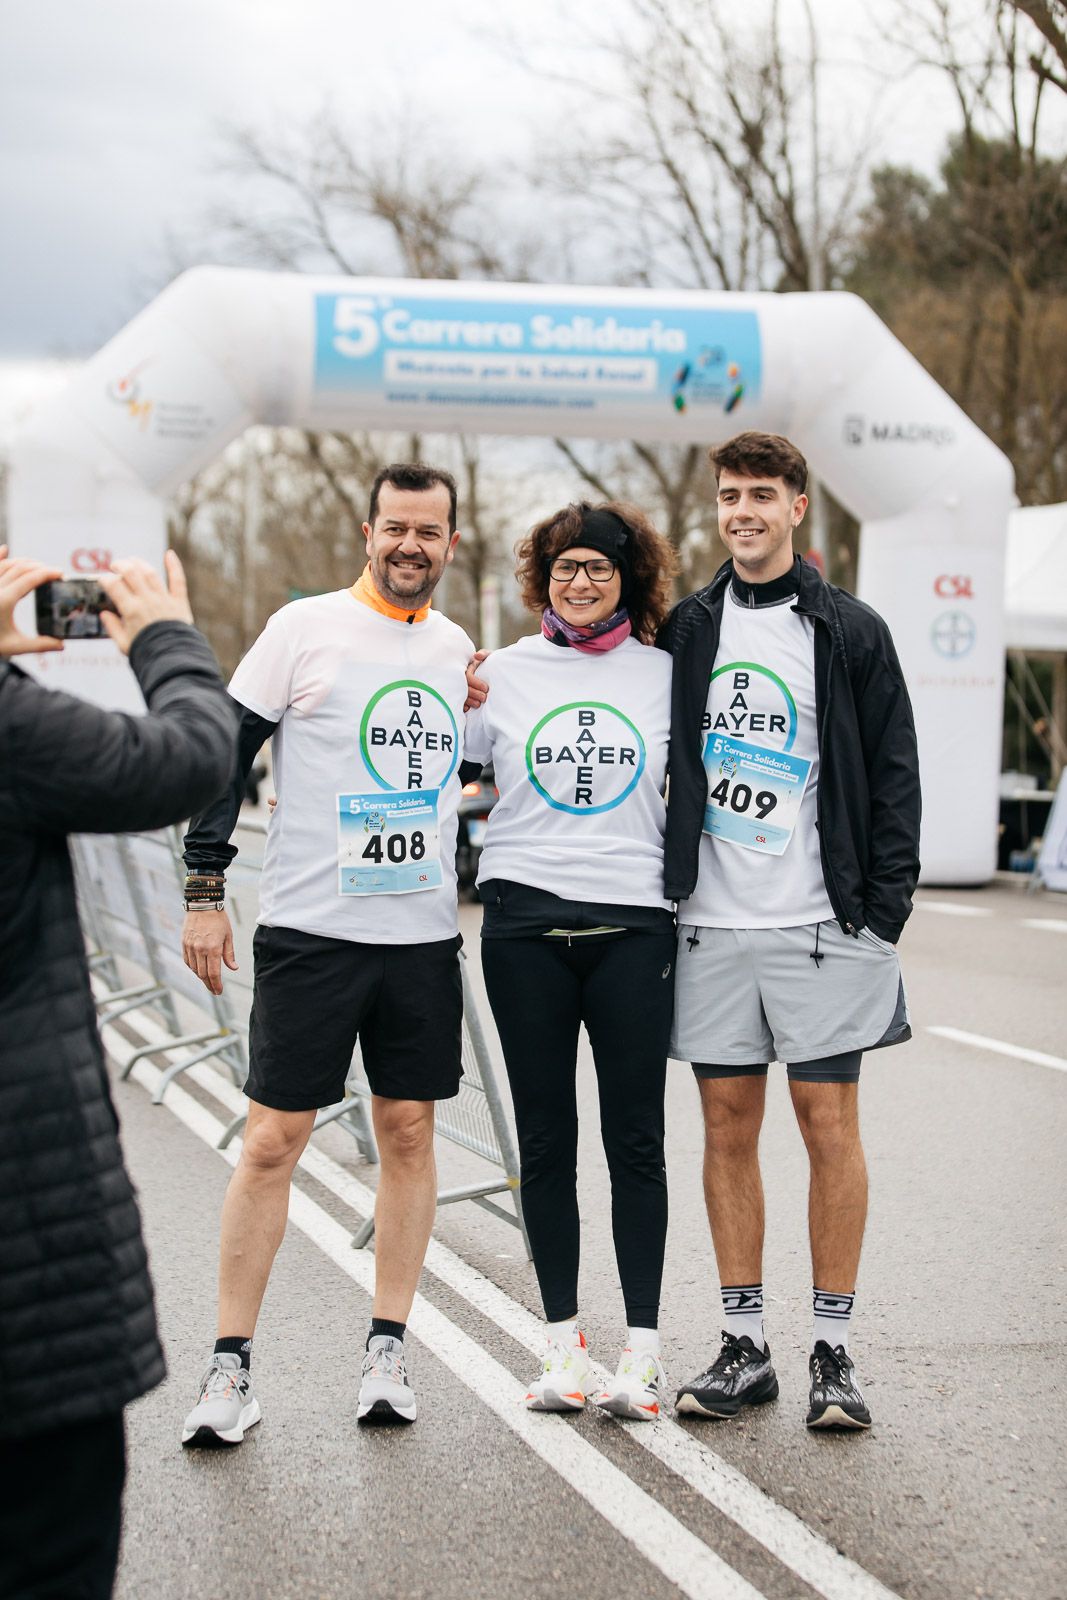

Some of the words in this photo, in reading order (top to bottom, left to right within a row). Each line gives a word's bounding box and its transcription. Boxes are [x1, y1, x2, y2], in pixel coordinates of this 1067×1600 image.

[382, 309, 522, 347] Carrera
[531, 314, 687, 352] Solidaria
[728, 672, 750, 738] BAY
[701, 712, 786, 733] BAYER
[371, 727, 453, 752] BAYER
[407, 690, 423, 789] BAYER
[535, 745, 636, 765] BAYER
[575, 710, 596, 805] BAYER
[723, 744, 753, 760] Carrera
[754, 753, 791, 771] Solidaria
[363, 801, 397, 810] Carrera
[398, 798, 426, 808] Solidaria
[711, 778, 778, 819] 409
[361, 831, 425, 863] 408
